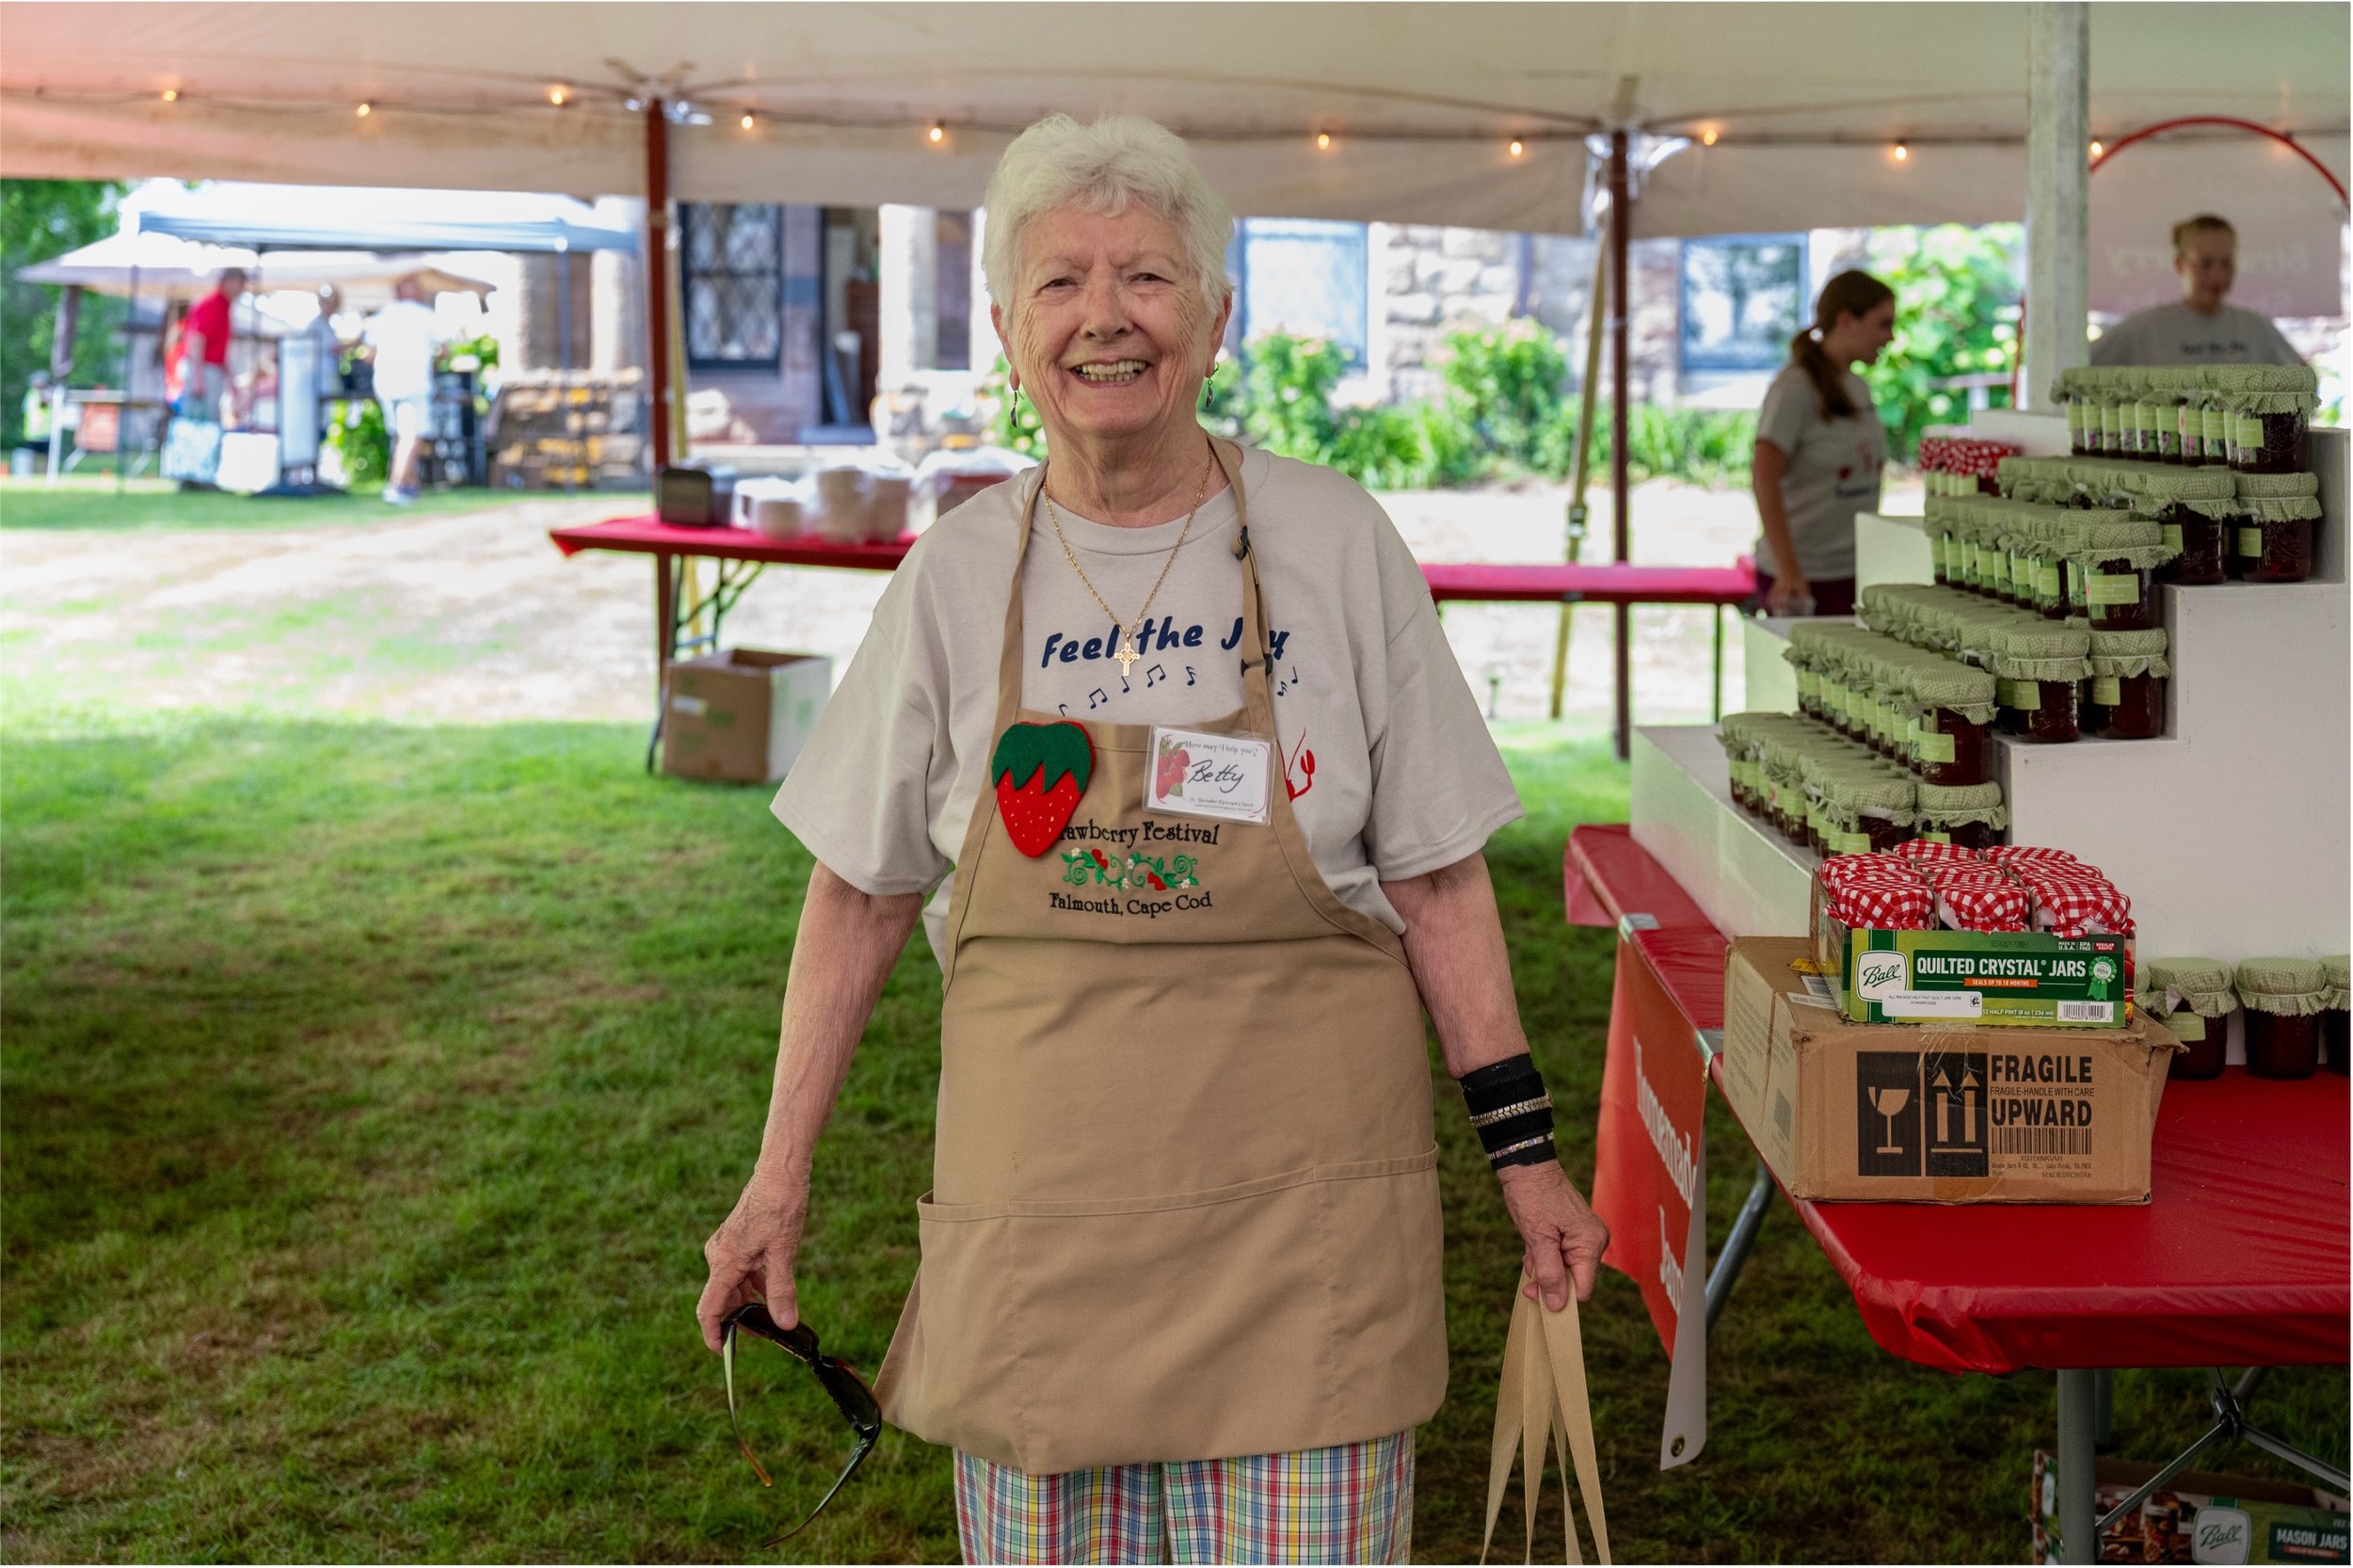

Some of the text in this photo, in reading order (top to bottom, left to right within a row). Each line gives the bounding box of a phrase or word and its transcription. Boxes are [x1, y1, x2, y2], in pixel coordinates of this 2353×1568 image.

[1041, 616, 1290, 668] Feel the Jy
[1184, 740, 1202, 749] How
[1203, 744, 1218, 753] may
[1188, 760, 1244, 793] Betty
[1058, 819, 1221, 849] rawberry Festival
[1049, 891, 1212, 919] Falmouth, Cape Cod
[1863, 964, 1901, 988] Ball
[1917, 957, 1975, 976] QUILTED
[2049, 961, 2086, 977] JARS
[1991, 1055, 2092, 1083] FRAGILE
[1990, 1086, 2095, 1097] FRAGILE-HANDLE WITH CARE
[1991, 1099, 2092, 1127] UPWARD
[2200, 1524, 2242, 1550] Ball
[2277, 1528, 2348, 1551] MASON JARS
